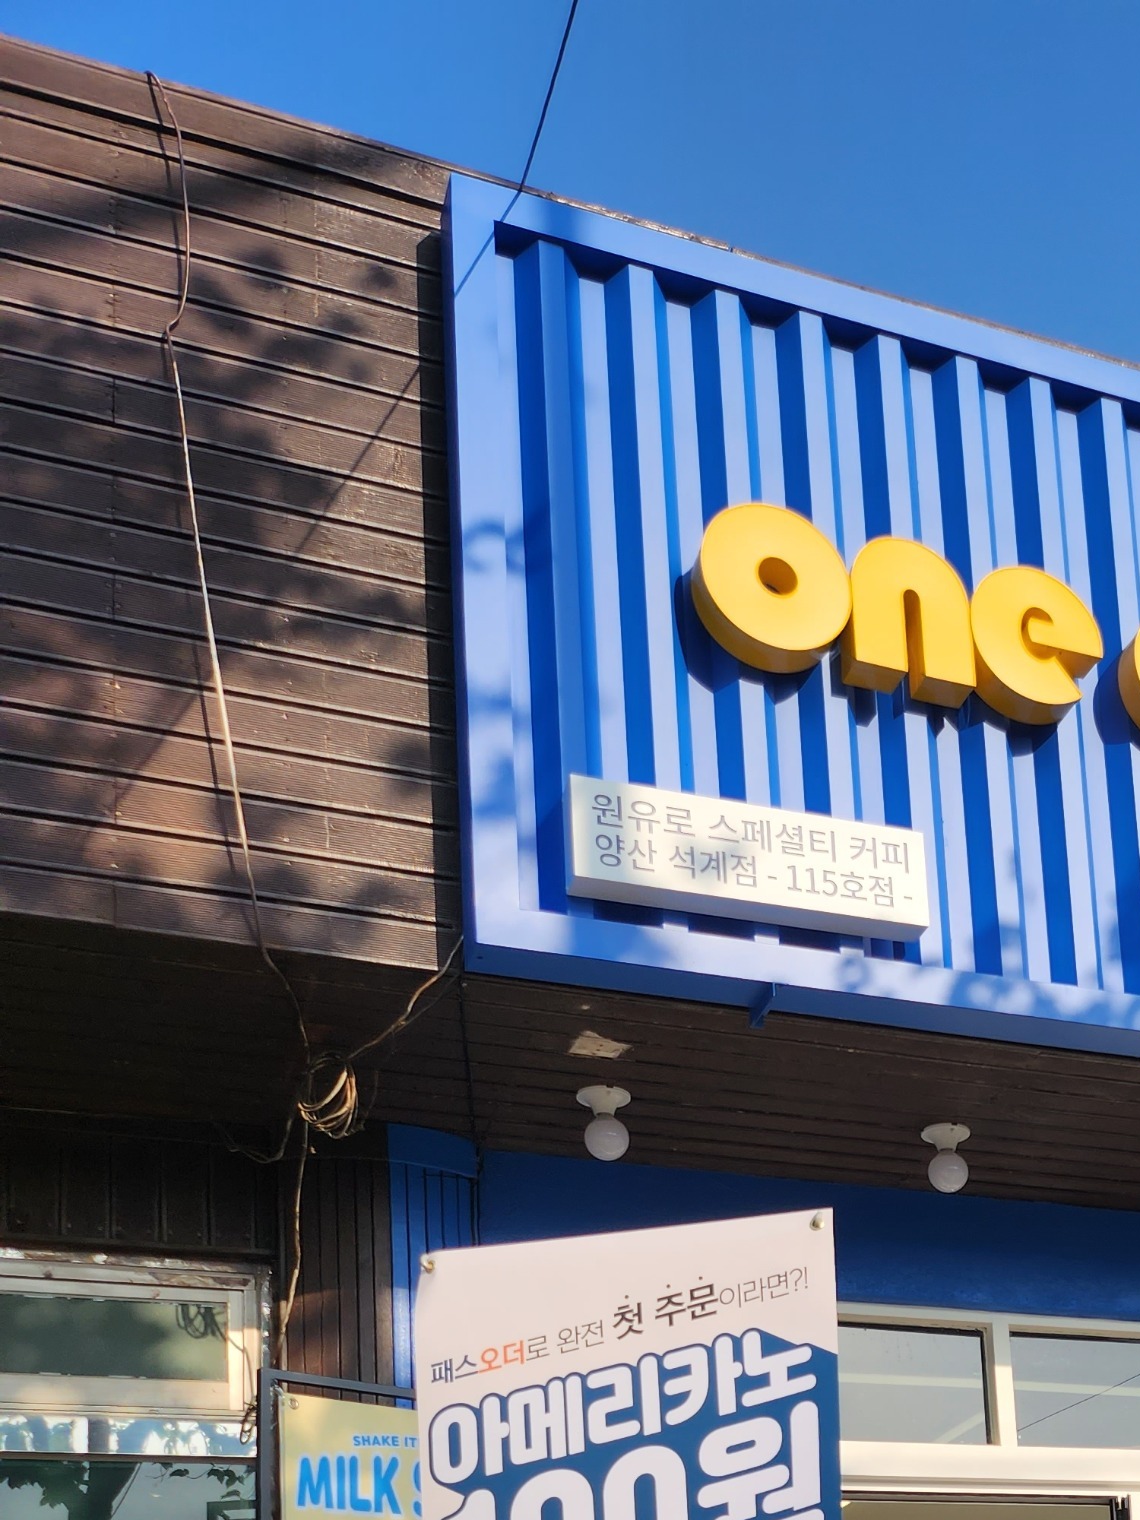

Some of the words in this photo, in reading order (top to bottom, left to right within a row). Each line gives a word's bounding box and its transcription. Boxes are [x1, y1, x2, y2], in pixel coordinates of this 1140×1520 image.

[591, 793, 696, 838] 원유로
[707, 814, 837, 863] 스페셜티
[849, 834, 911, 875] 커피
[595, 832, 658, 873] 양산
[668, 845, 758, 889] 석계점
[786, 863, 896, 909] 115호점
[430, 1334, 550, 1385] 패스오더로
[556, 1319, 605, 1355] 완전
[612, 1300, 644, 1340] 첫
[654, 1266, 810, 1328] 주문이라면?!
[353, 1435, 400, 1447] SHAKE
[404, 1436, 417, 1448] IT
[429, 1328, 818, 1485] 아메리카노
[297, 1455, 402, 1515] MILK
